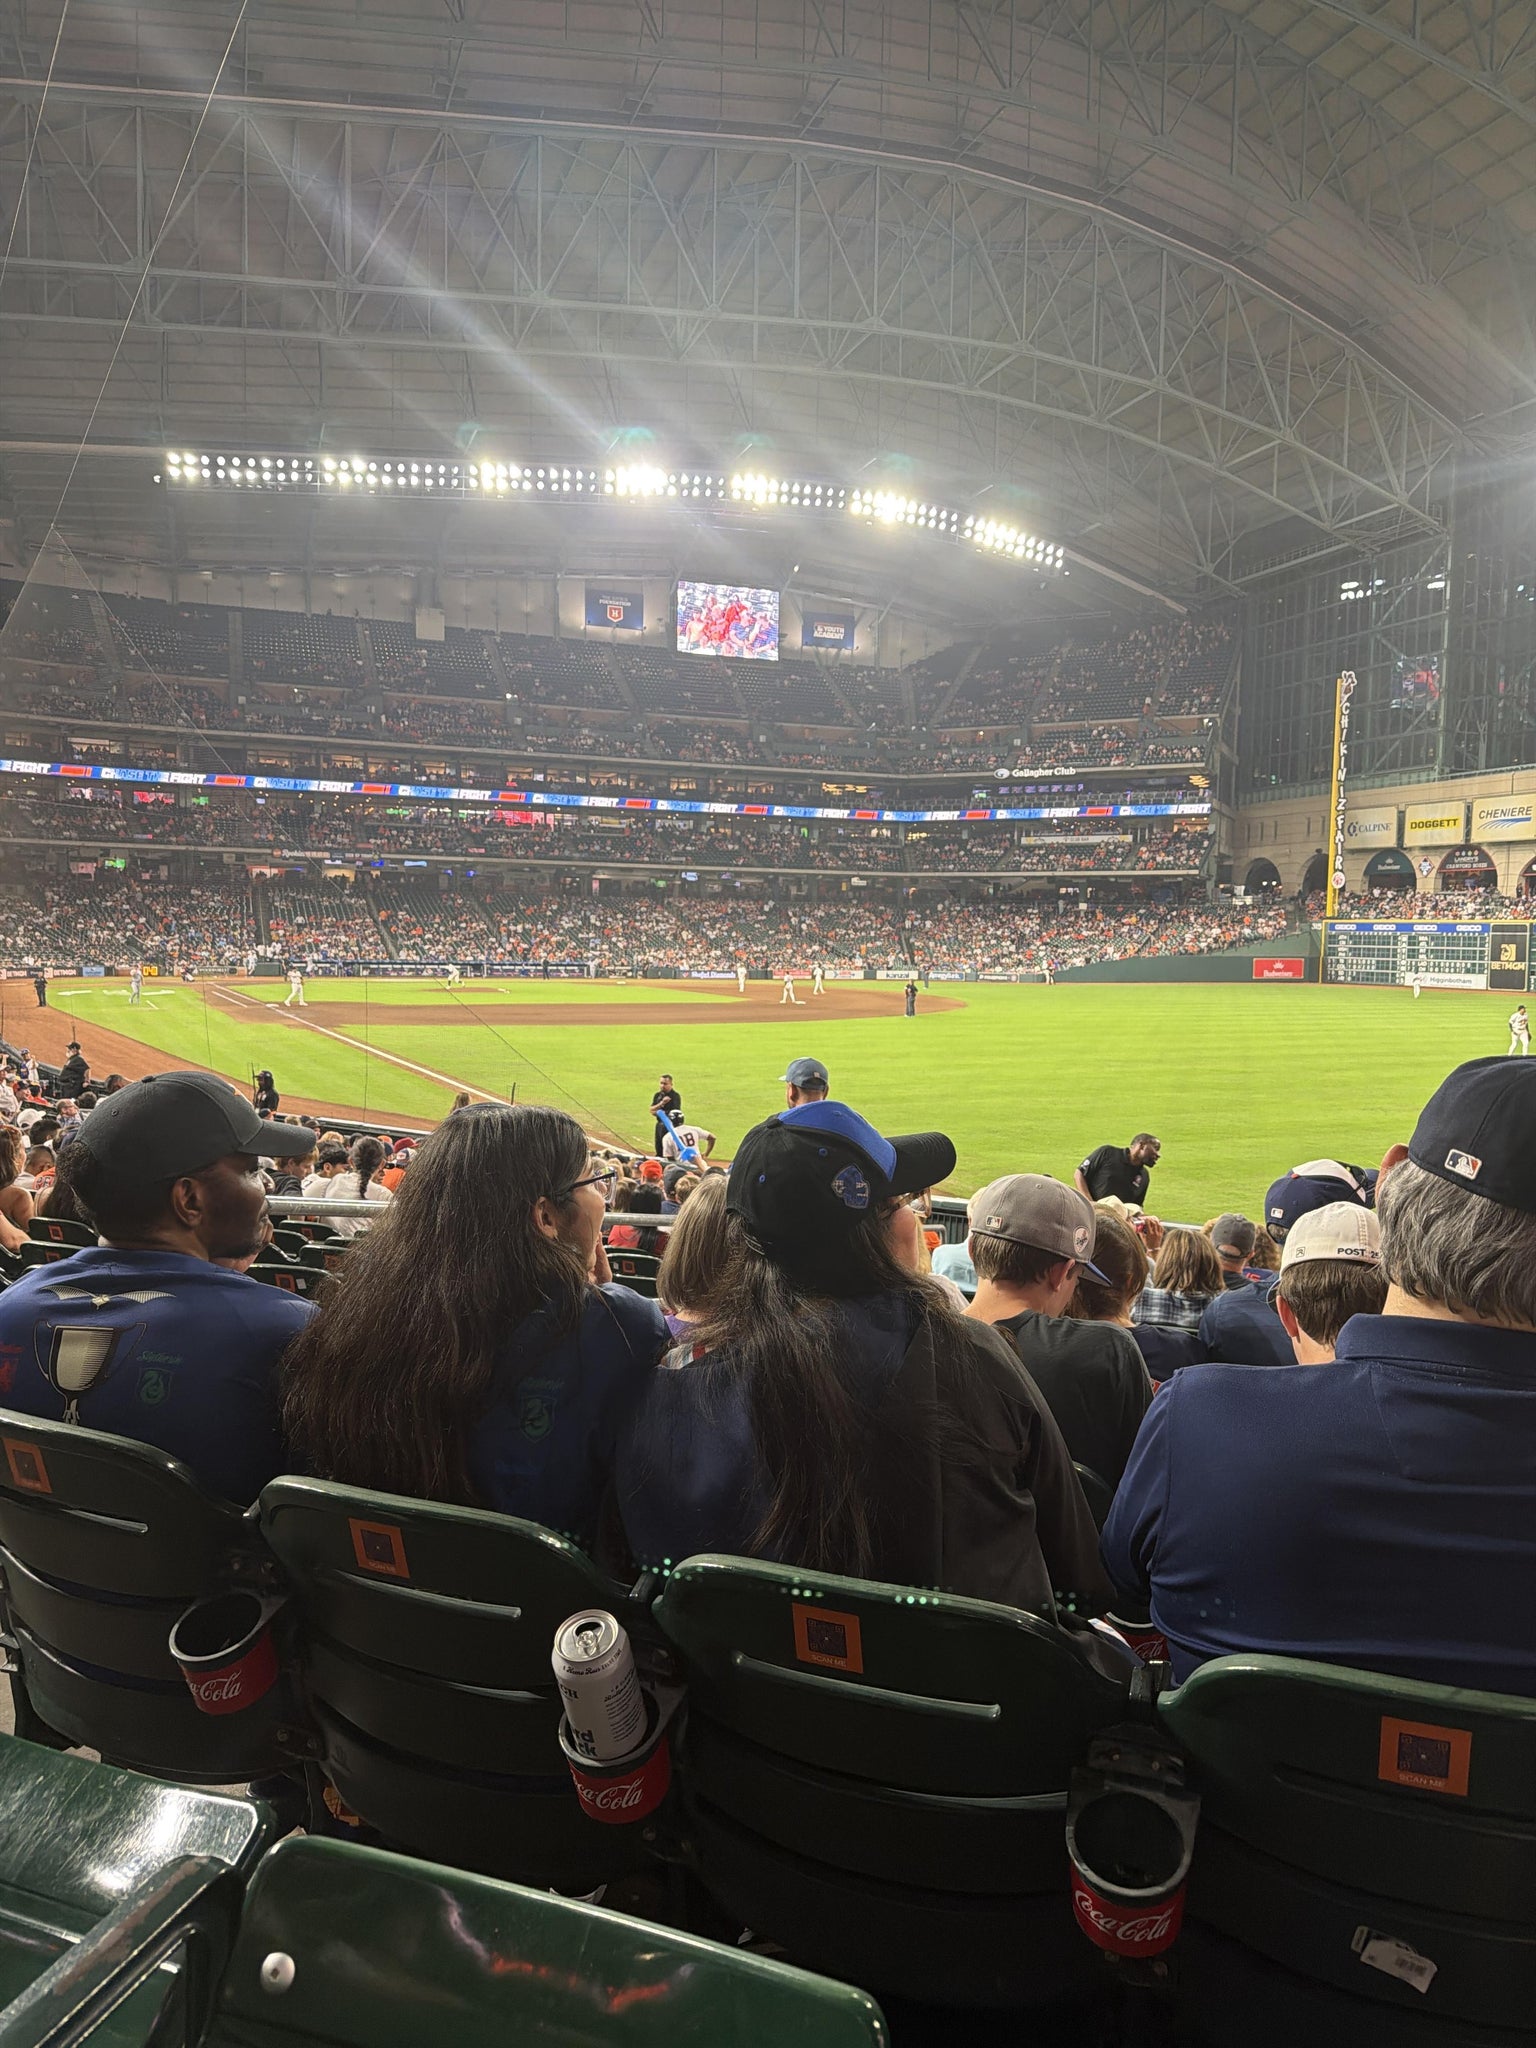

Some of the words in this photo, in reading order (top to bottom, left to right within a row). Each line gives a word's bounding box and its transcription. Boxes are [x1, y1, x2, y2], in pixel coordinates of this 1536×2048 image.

[170, 772, 207, 784] FIGHT
[1012, 768, 1053, 778] Gallagher
[1054, 767, 1076, 775] Club
[319, 780, 354, 792] FIGHT
[460, 789, 492, 801] FIGHT
[1479, 806, 1532, 819] CHENIERE
[1359, 823, 1391, 832] CALPINE
[1411, 818, 1459, 830] DOGGETT
[1334, 814, 1345, 870] FAIR
[1491, 962, 1525, 970] BETMGM
[1430, 977, 1472, 986] Higginbotham
[1337, 1247, 1366, 1256] POST
[811, 1654, 833, 1665] SCAN
[566, 1665, 584, 1675] Home
[585, 1666, 600, 1675] Run
[187, 1669, 242, 1701] a-Cola
[1399, 1773, 1427, 1785] SCAN
[1075, 1890, 1176, 1942] Coca-Cola
